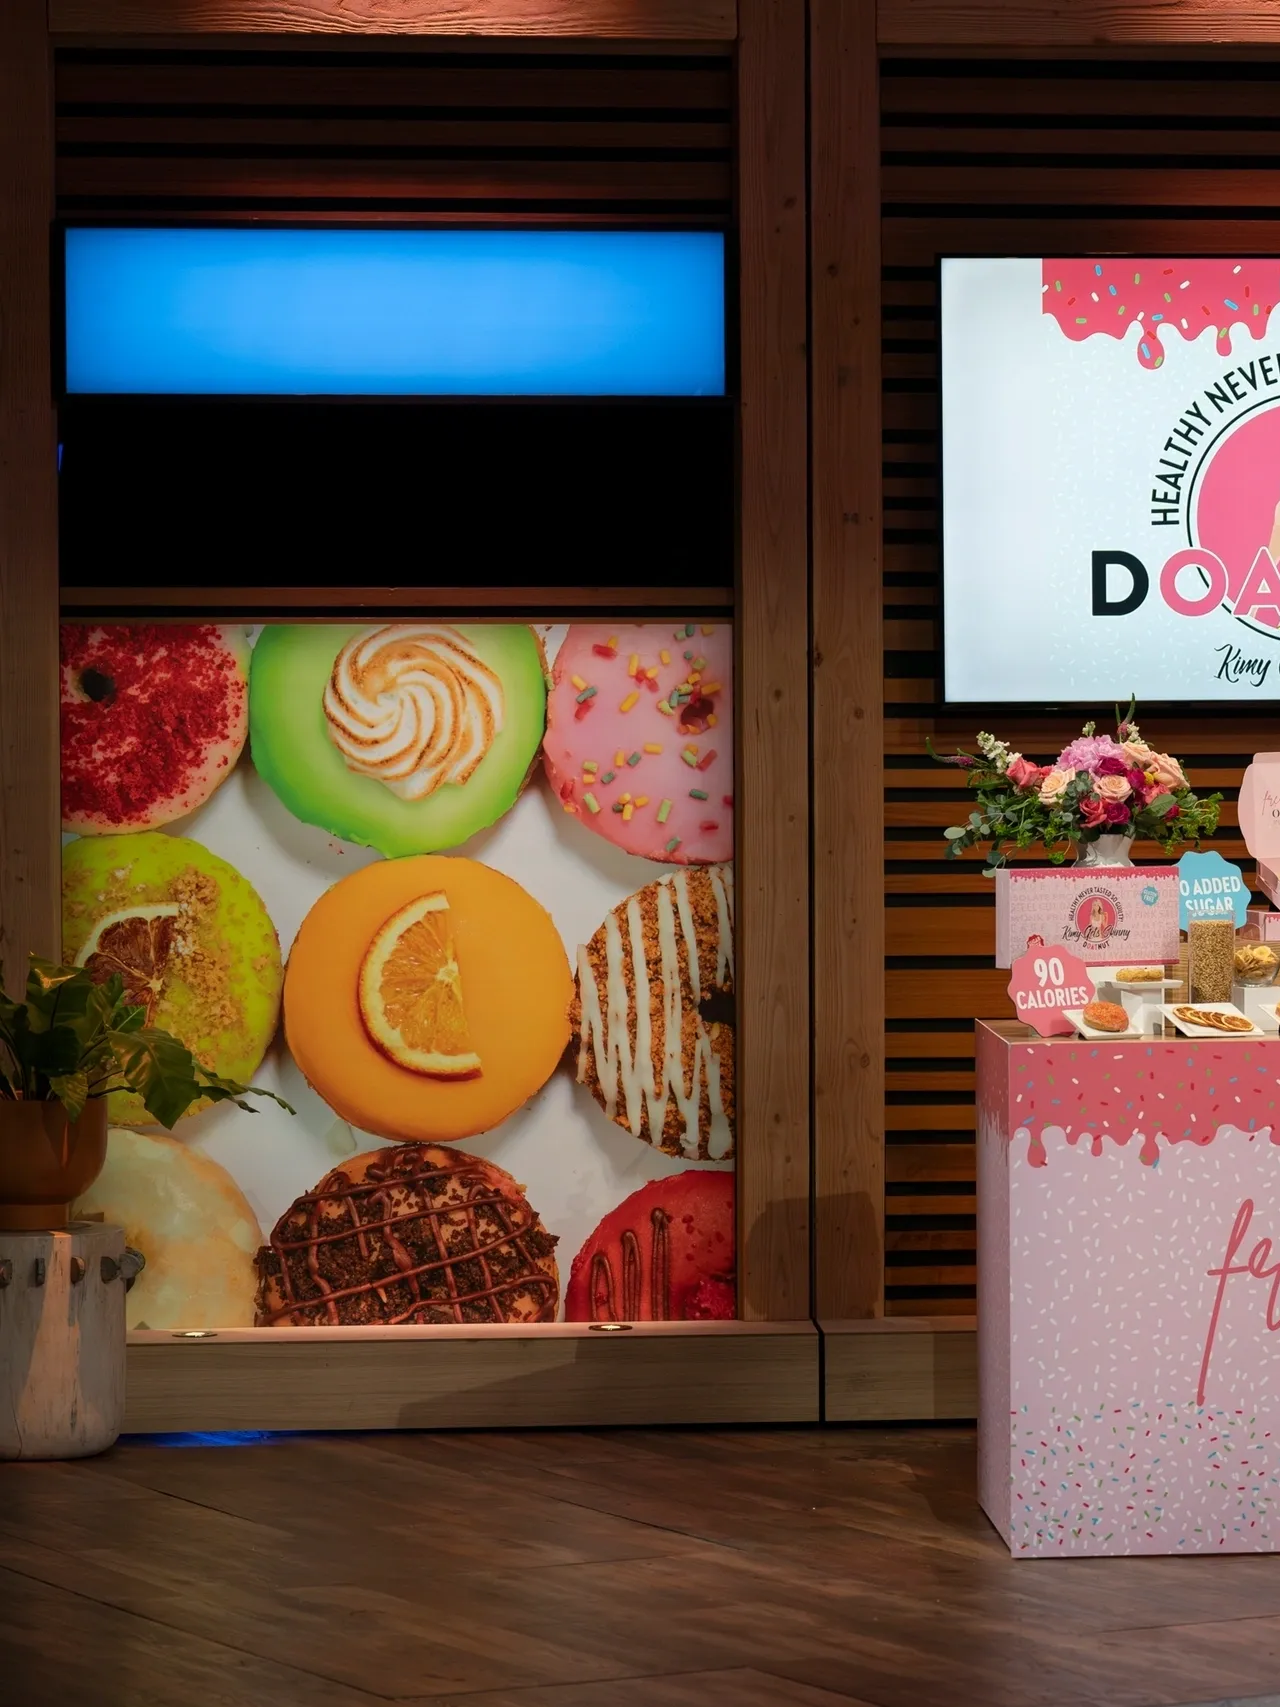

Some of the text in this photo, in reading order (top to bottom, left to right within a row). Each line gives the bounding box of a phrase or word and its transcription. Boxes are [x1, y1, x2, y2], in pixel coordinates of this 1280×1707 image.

[1151, 401, 1212, 525] HEALTHY
[1214, 643, 1272, 686] Kimy
[1094, 886, 1112, 897] TASTED
[1193, 876, 1241, 896] ADDED
[1185, 896, 1234, 916] SUGAR
[1033, 957, 1064, 988] 90
[1016, 986, 1089, 1010] CALORIES
